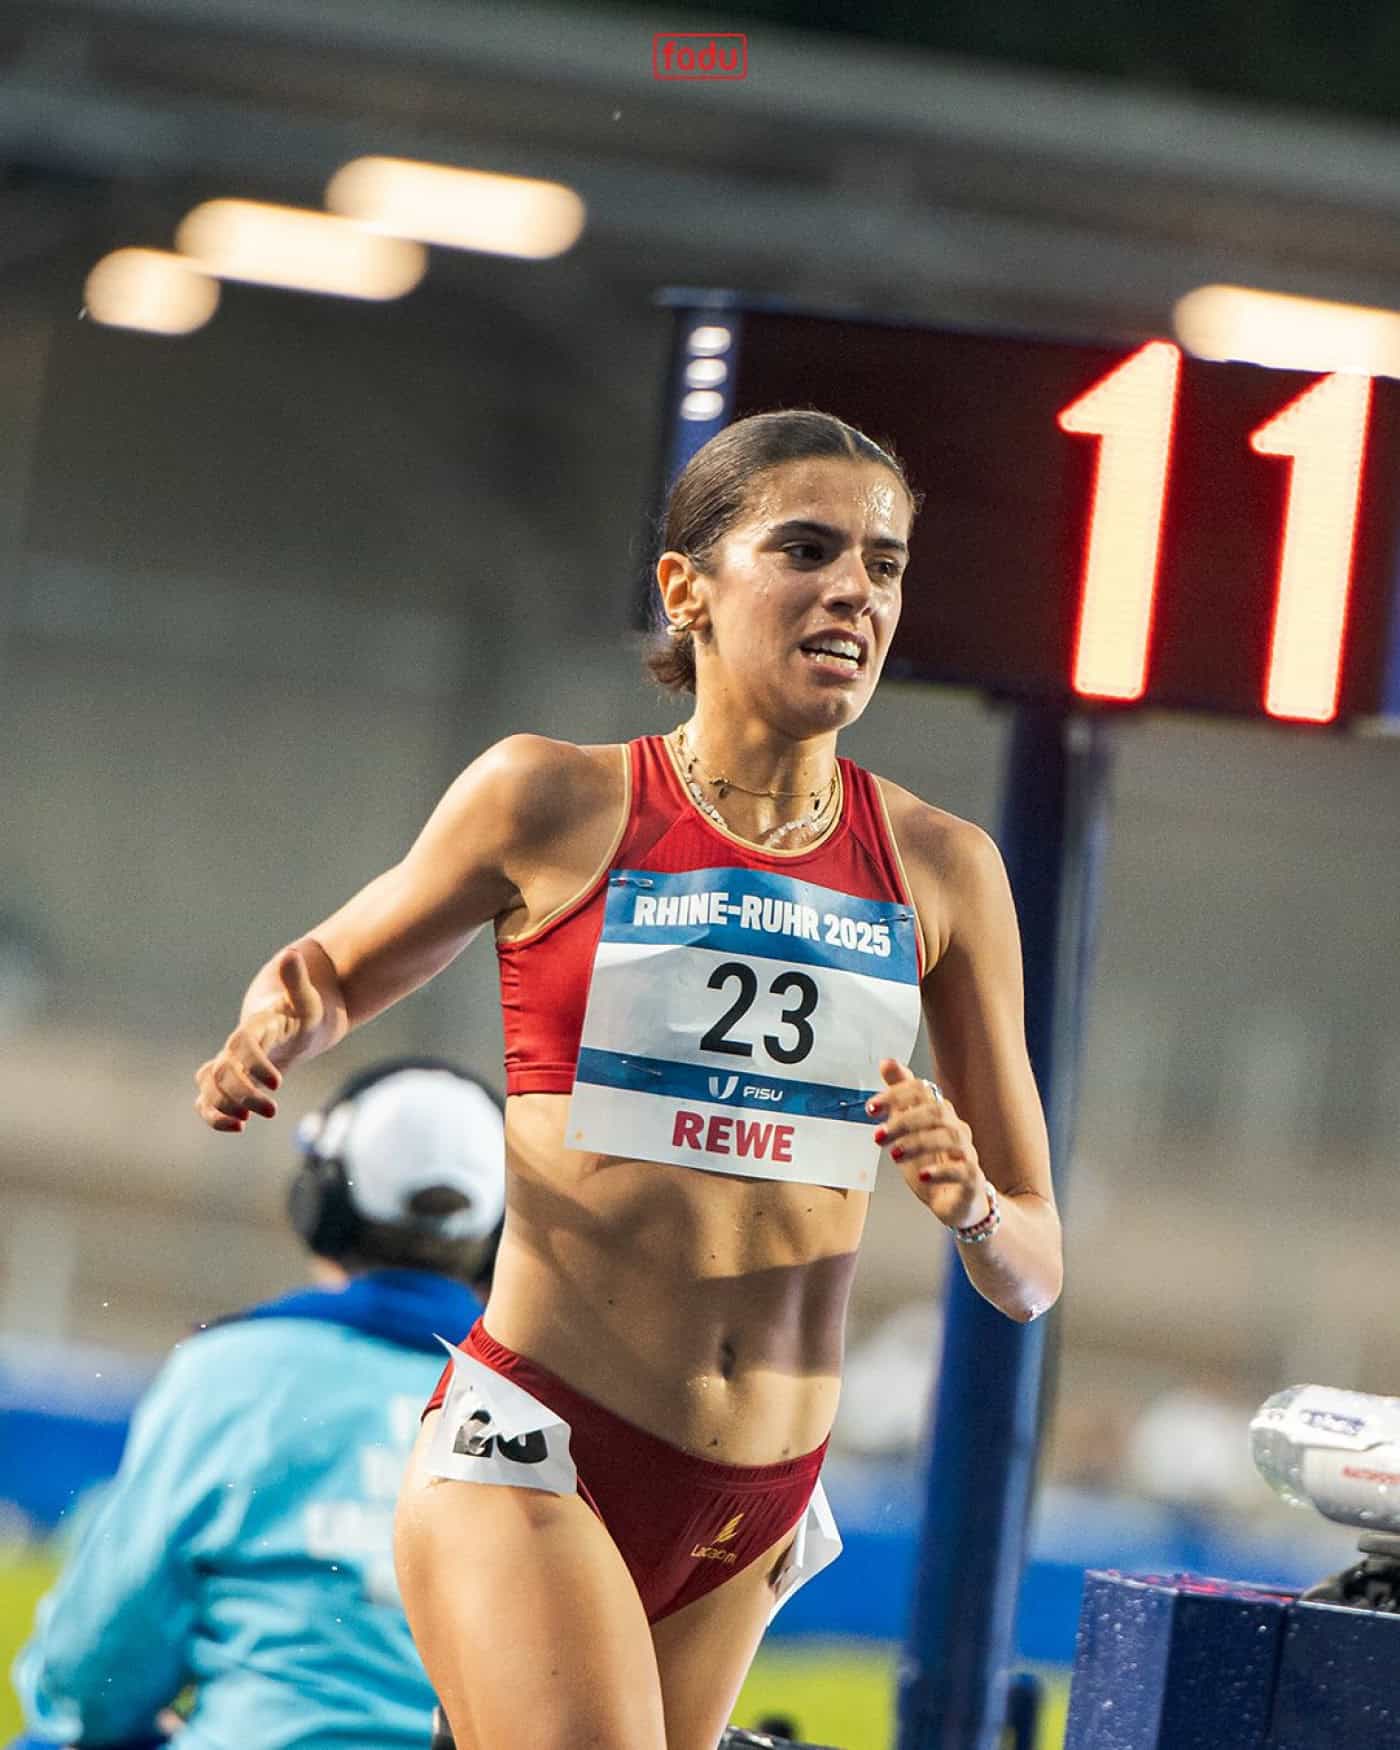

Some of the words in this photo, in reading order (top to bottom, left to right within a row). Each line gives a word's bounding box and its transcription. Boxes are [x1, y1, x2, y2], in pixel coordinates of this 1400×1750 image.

[633, 892, 819, 942] RHINE-RUHR
[824, 916, 891, 957] 2025
[700, 962, 819, 1065] 23
[742, 1085, 784, 1102] FISU
[671, 1110, 795, 1163] REWE
